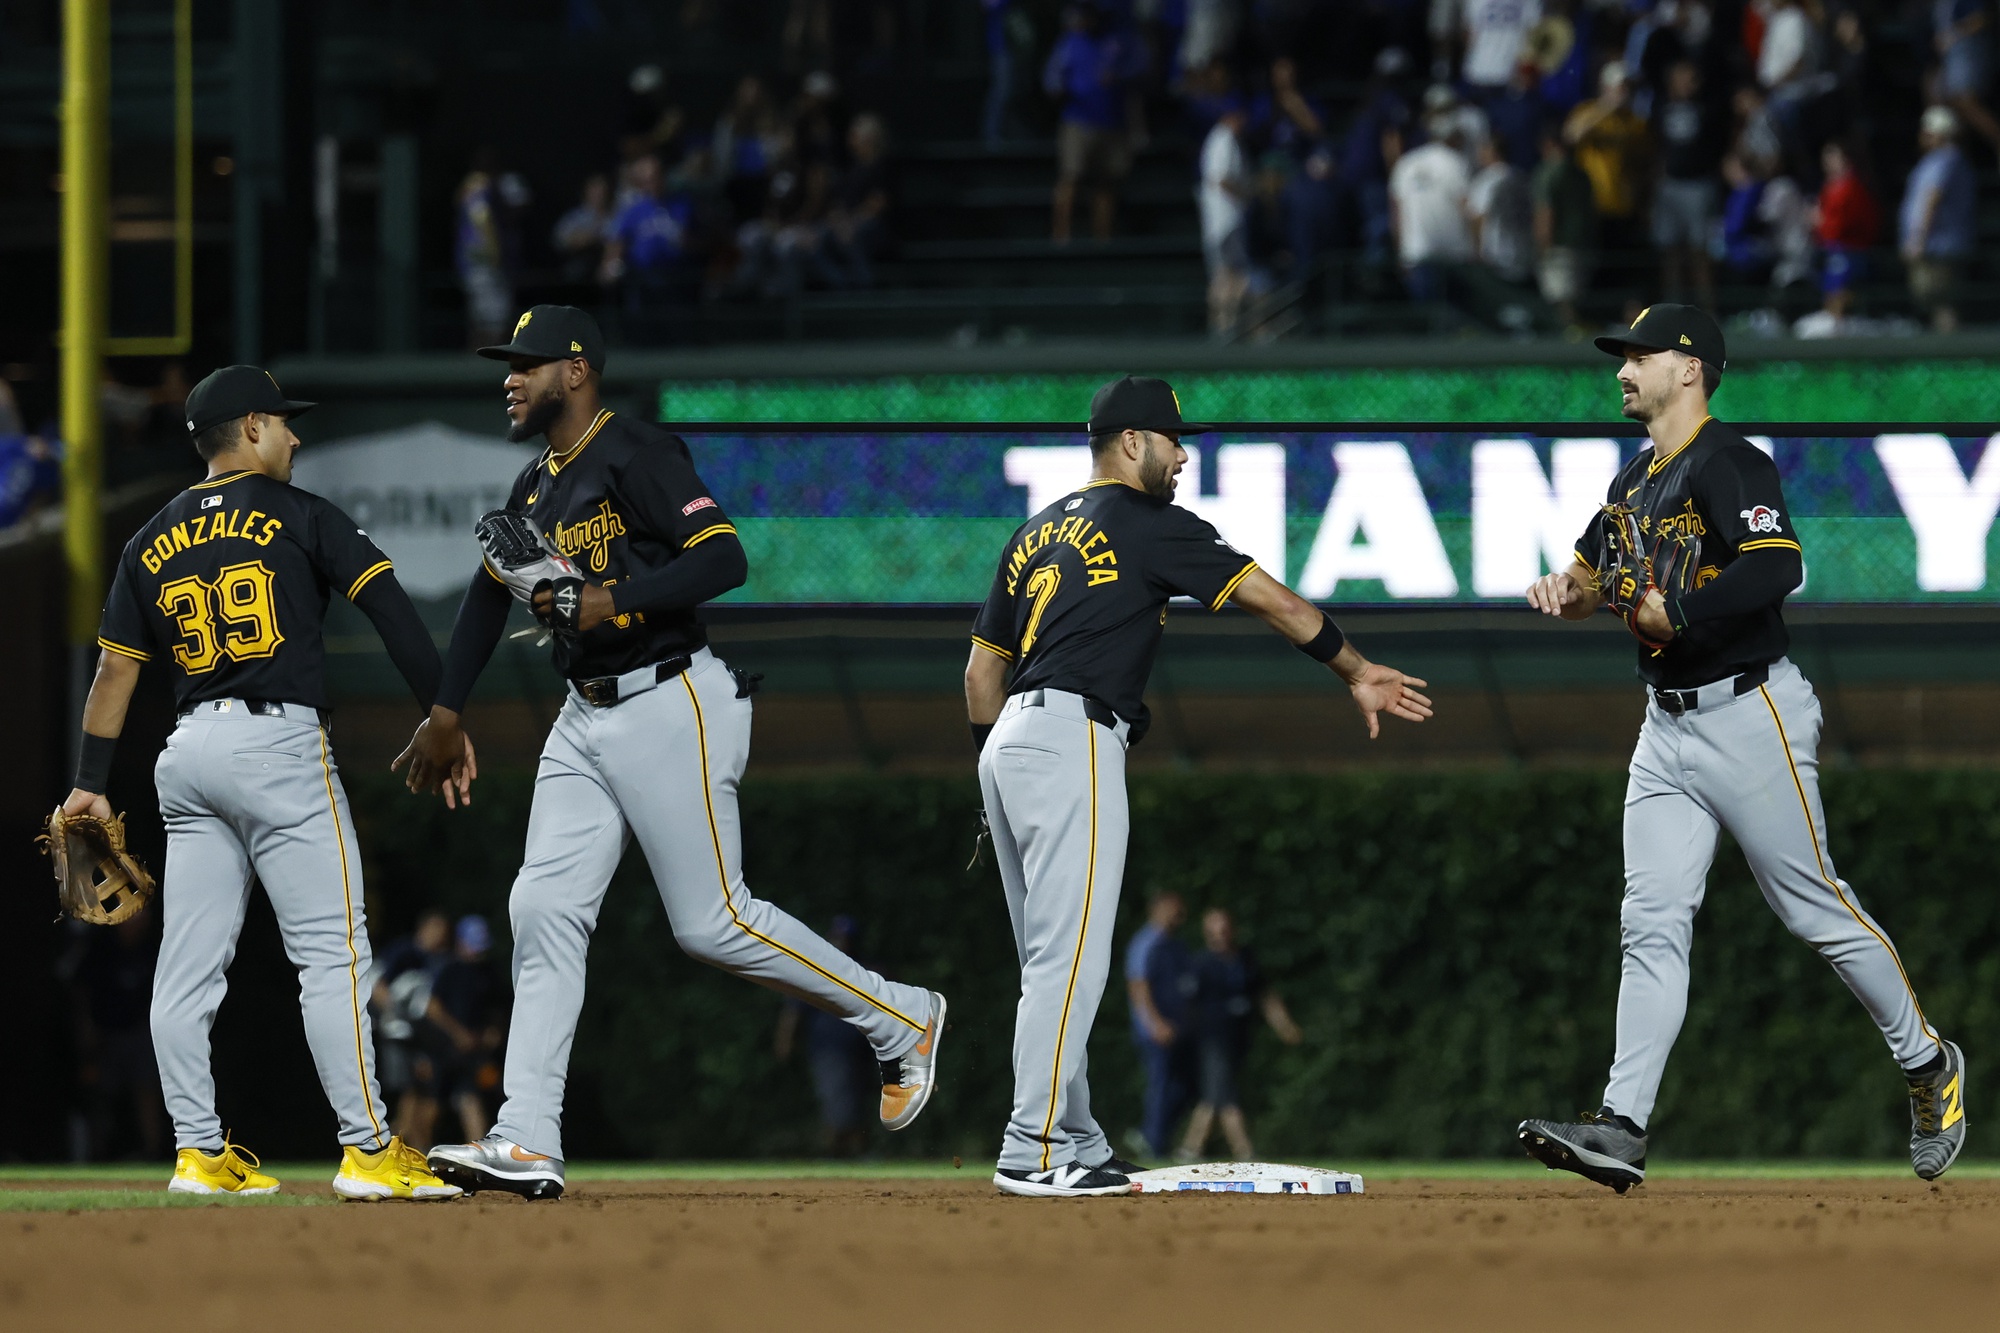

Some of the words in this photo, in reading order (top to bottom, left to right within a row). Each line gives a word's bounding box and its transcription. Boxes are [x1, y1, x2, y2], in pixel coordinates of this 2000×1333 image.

[141, 509, 282, 575] GONZALES
[1004, 440, 1807, 600] THAN
[1007, 516, 1118, 596] KINER-FALEFA
[156, 560, 285, 675] 39
[556, 585, 577, 618] 44
[1021, 564, 1062, 657] 7
